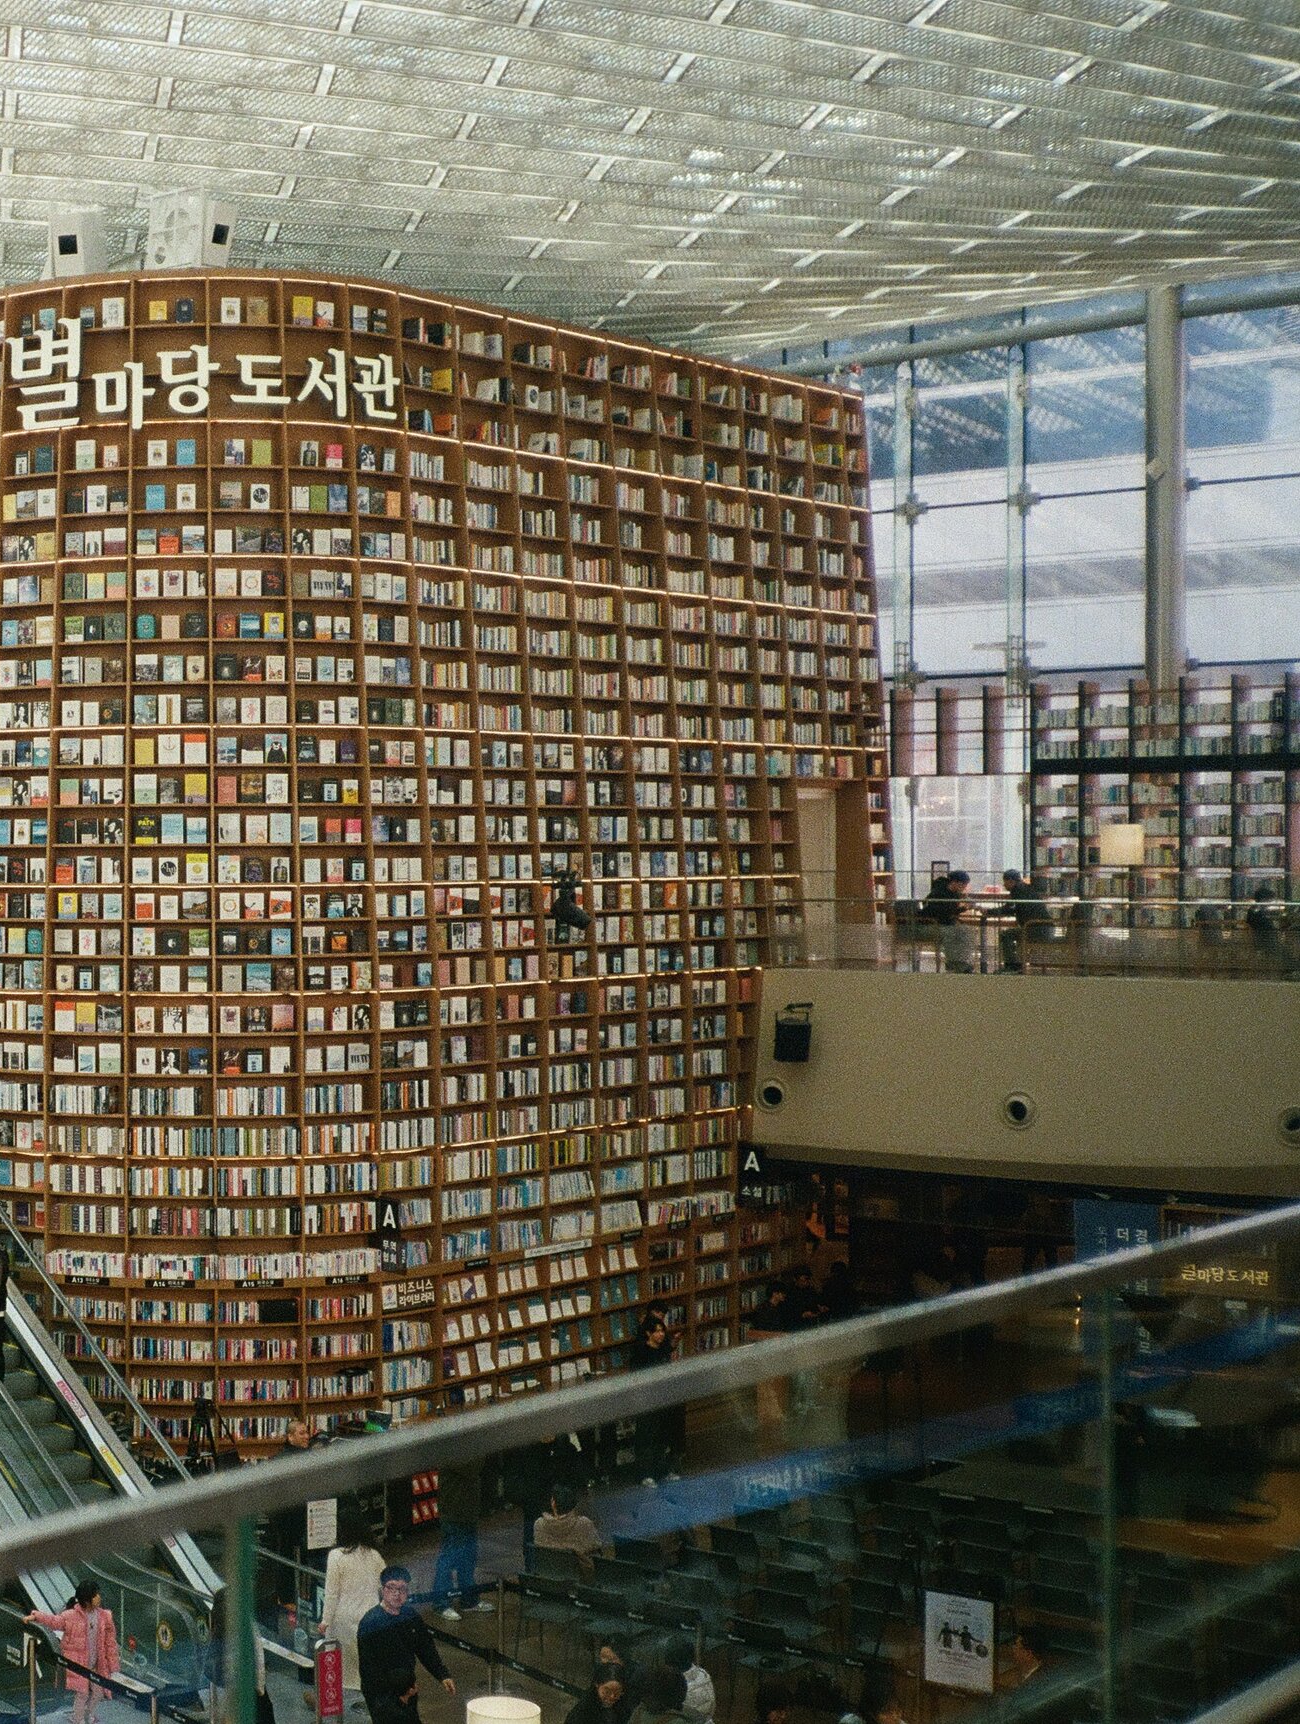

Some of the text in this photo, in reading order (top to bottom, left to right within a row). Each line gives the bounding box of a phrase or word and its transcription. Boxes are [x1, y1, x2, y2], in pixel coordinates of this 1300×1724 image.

[743, 1151, 760, 1172] A
[382, 1203, 397, 1229] A
[397, 1278, 434, 1295] 비즈니스
[398, 1290, 435, 1307] 라이브러리
